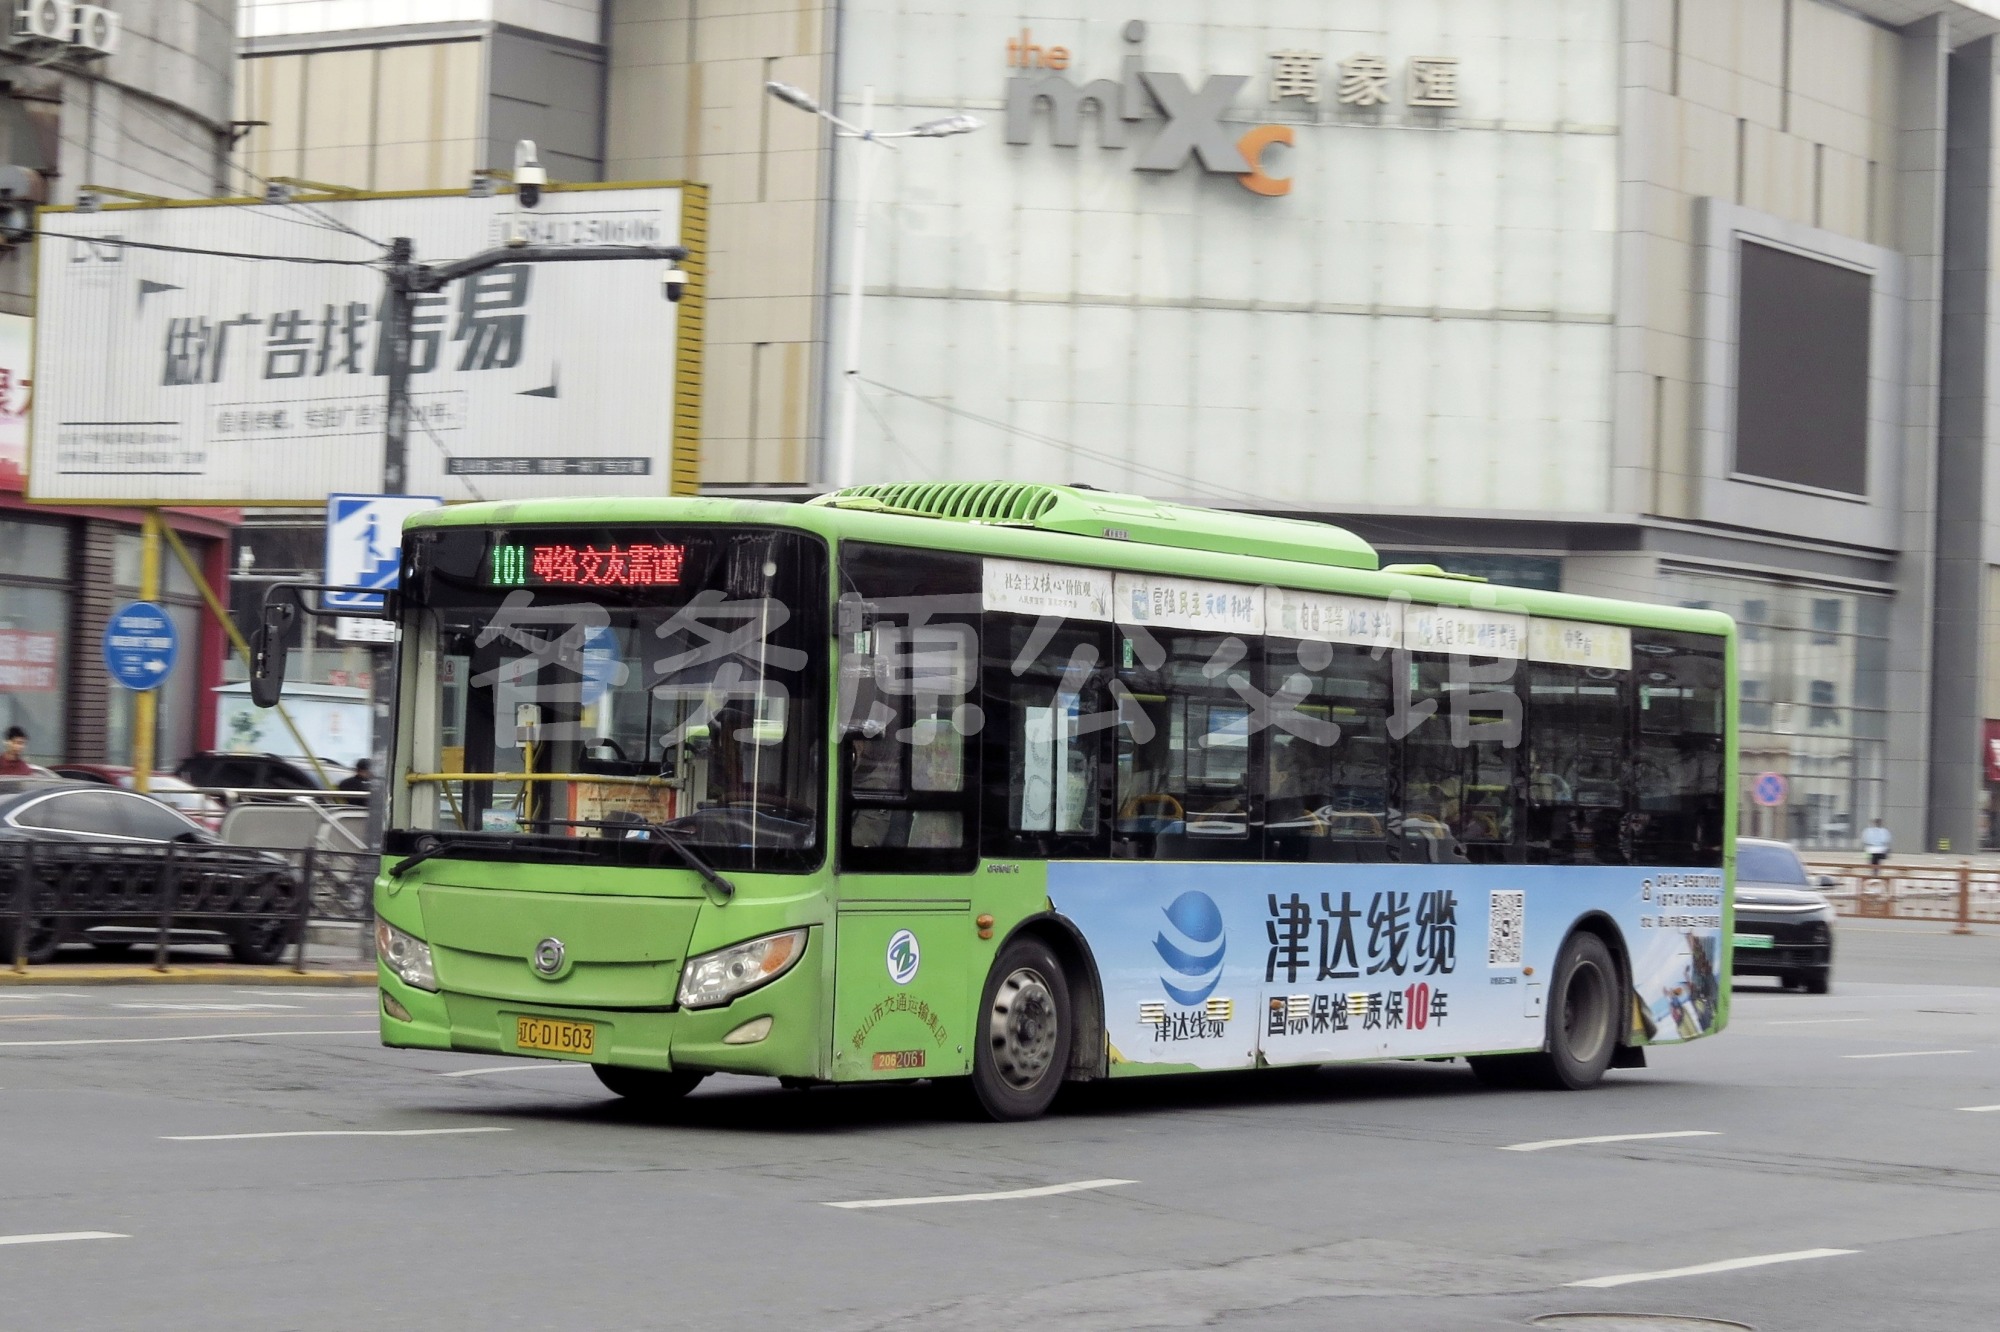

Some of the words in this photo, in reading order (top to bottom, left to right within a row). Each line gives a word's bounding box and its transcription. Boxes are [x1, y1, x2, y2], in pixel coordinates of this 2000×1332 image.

[1006, 28, 1071, 71] the
[1267, 50, 1460, 107] 萬象匯
[161, 262, 534, 387] 做广告找信易
[493, 546, 525, 584] 101
[534, 545, 684, 585] 网络交友需谨
[1005, 573, 1092, 597] 社会主义核心价值观
[1265, 889, 1458, 983] 津达线缆
[852, 992, 948, 1051] 鞍山市交通运输集团
[1154, 1008, 1226, 1042] 津达线缆
